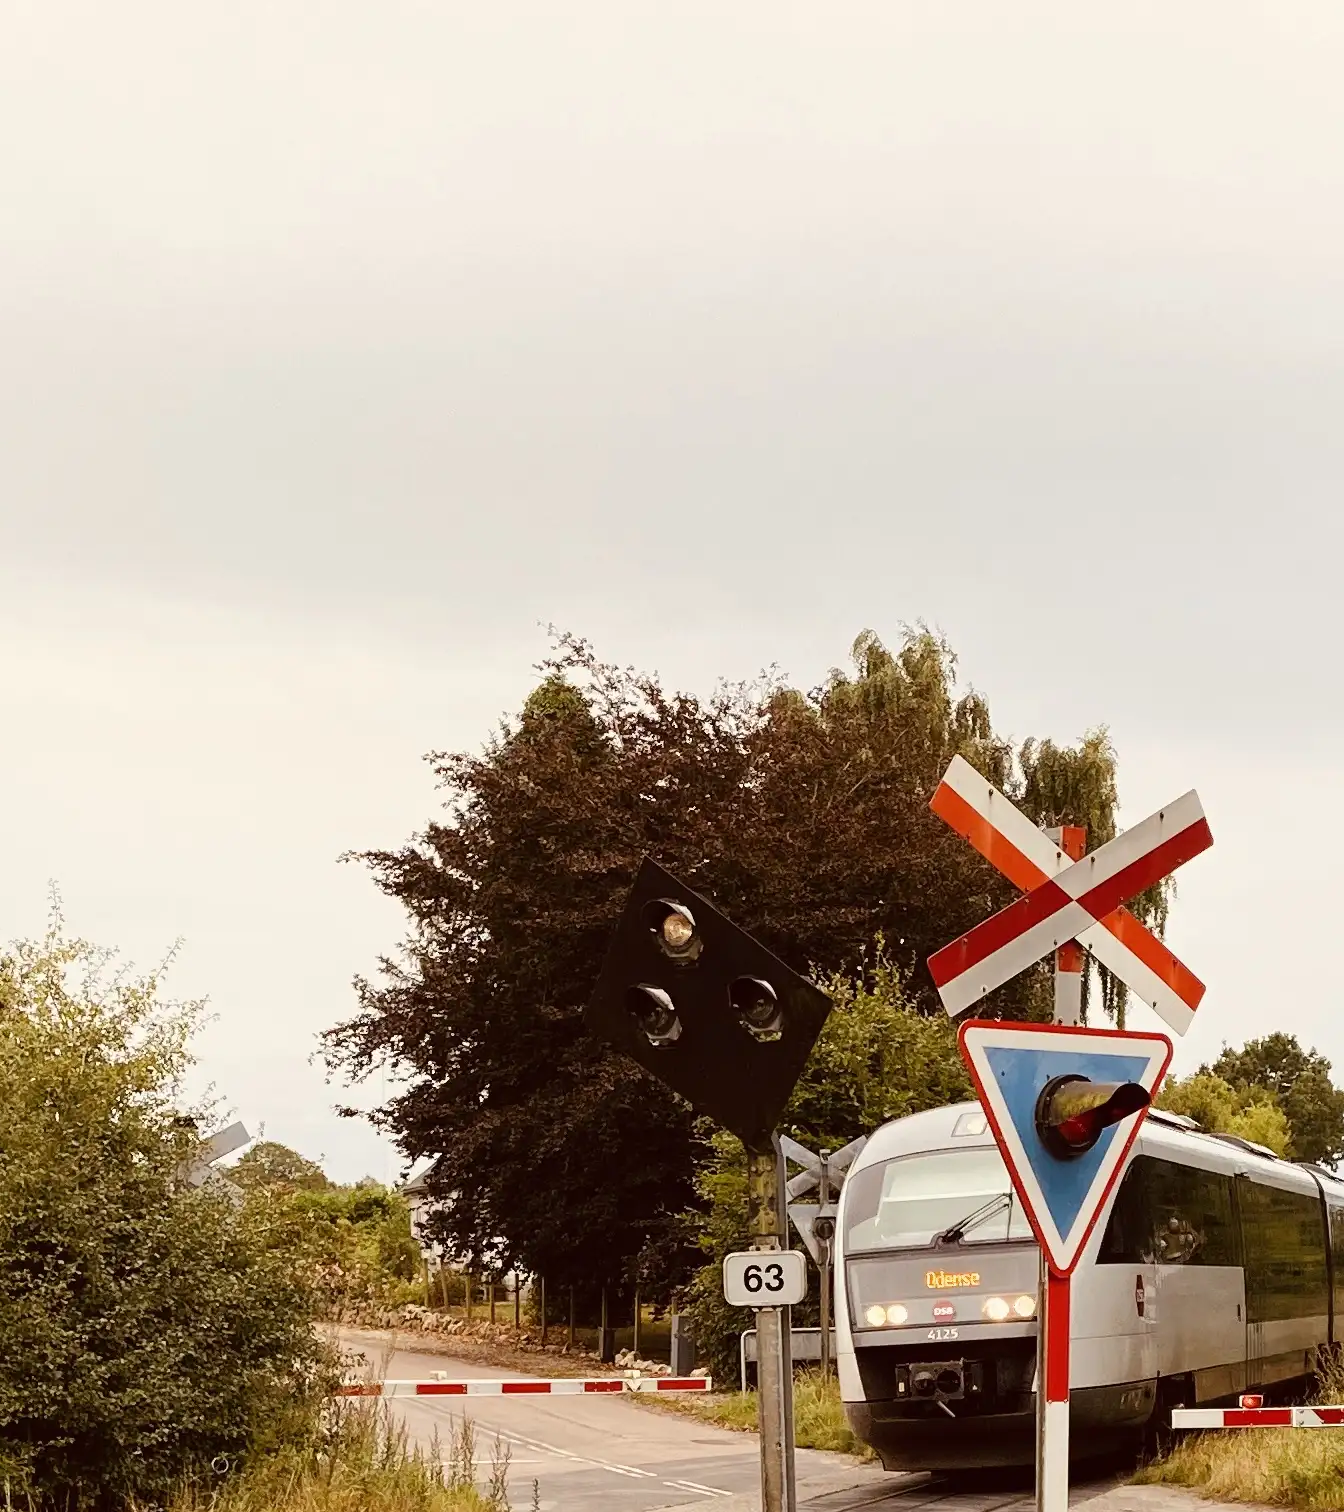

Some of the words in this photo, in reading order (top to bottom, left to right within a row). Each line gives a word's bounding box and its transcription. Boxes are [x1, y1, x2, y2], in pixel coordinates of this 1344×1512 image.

[743, 1263, 784, 1293] 63
[926, 1270, 980, 1289] Odense
[933, 1306, 954, 1316] DSB
[927, 1327, 959, 1341] 4125
